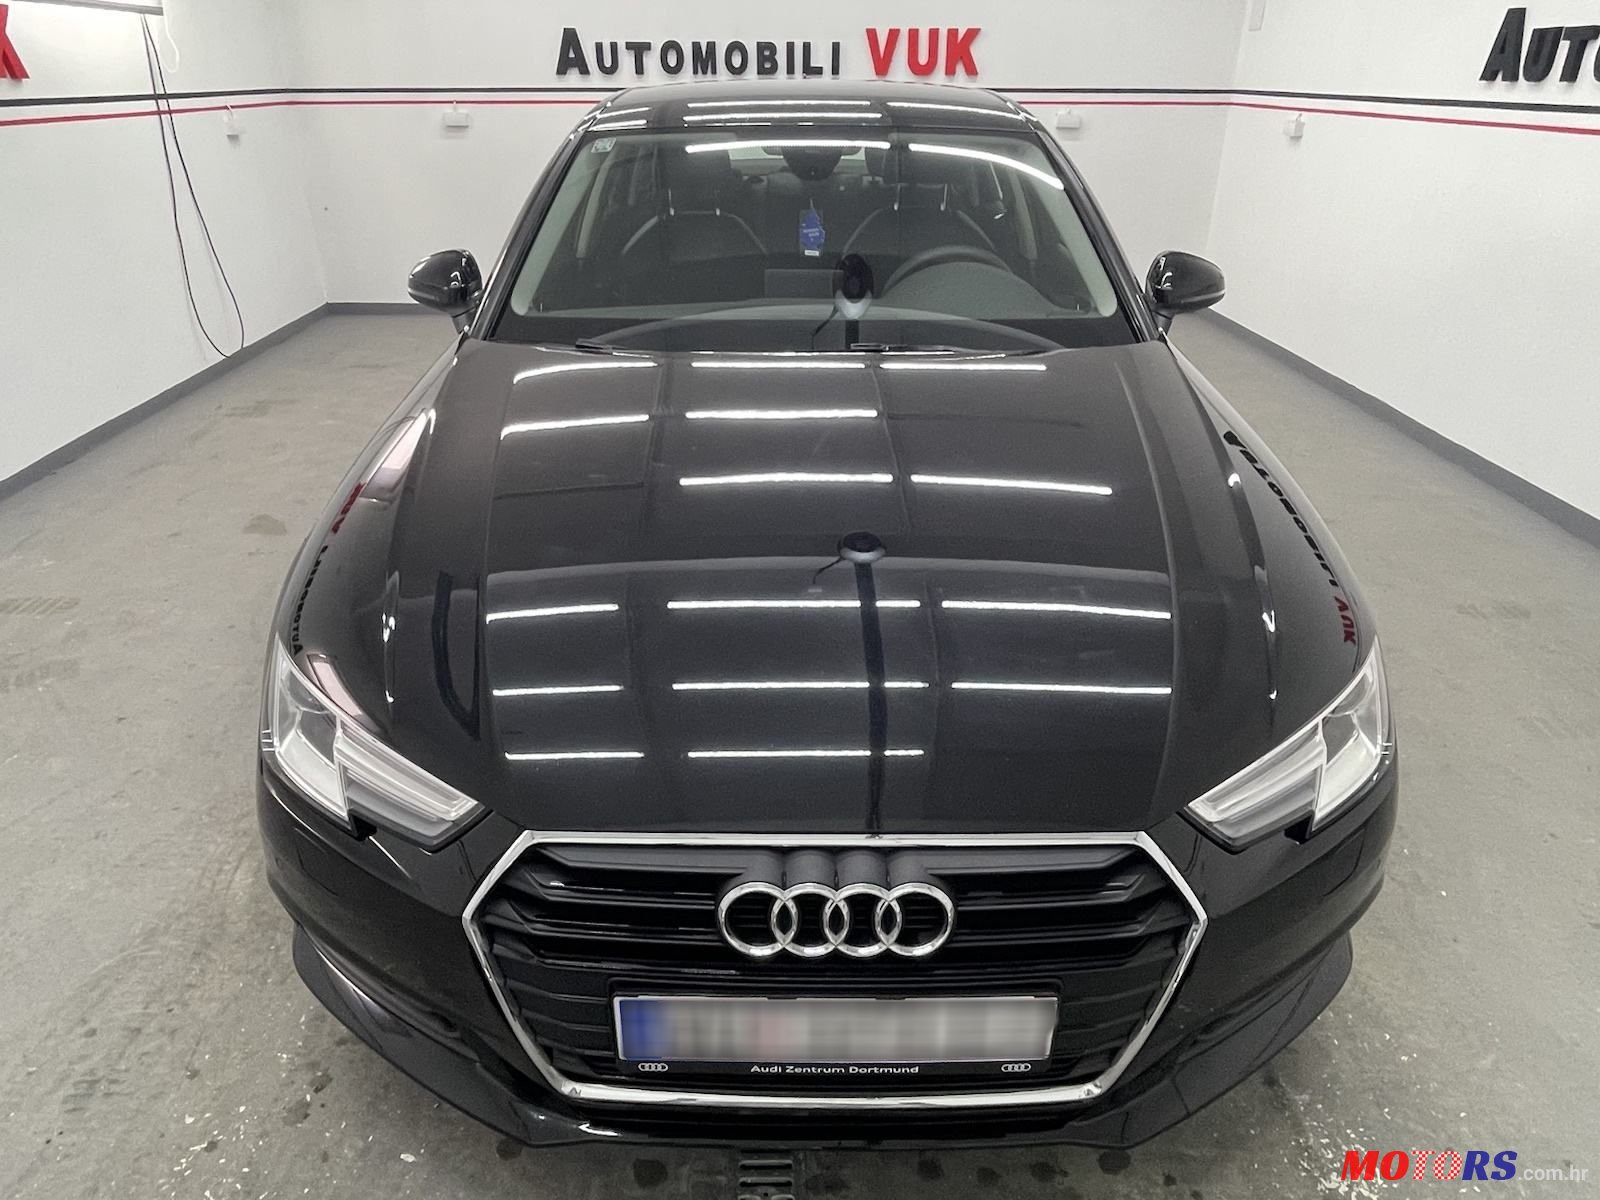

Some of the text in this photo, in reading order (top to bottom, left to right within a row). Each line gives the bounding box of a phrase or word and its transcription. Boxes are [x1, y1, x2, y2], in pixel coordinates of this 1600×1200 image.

[556, 28, 981, 76] AUTOMOBILI VUK
[1478, 7, 1600, 82] AUT
[751, 1065, 919, 1075] Audi Zentrum Dortmund
